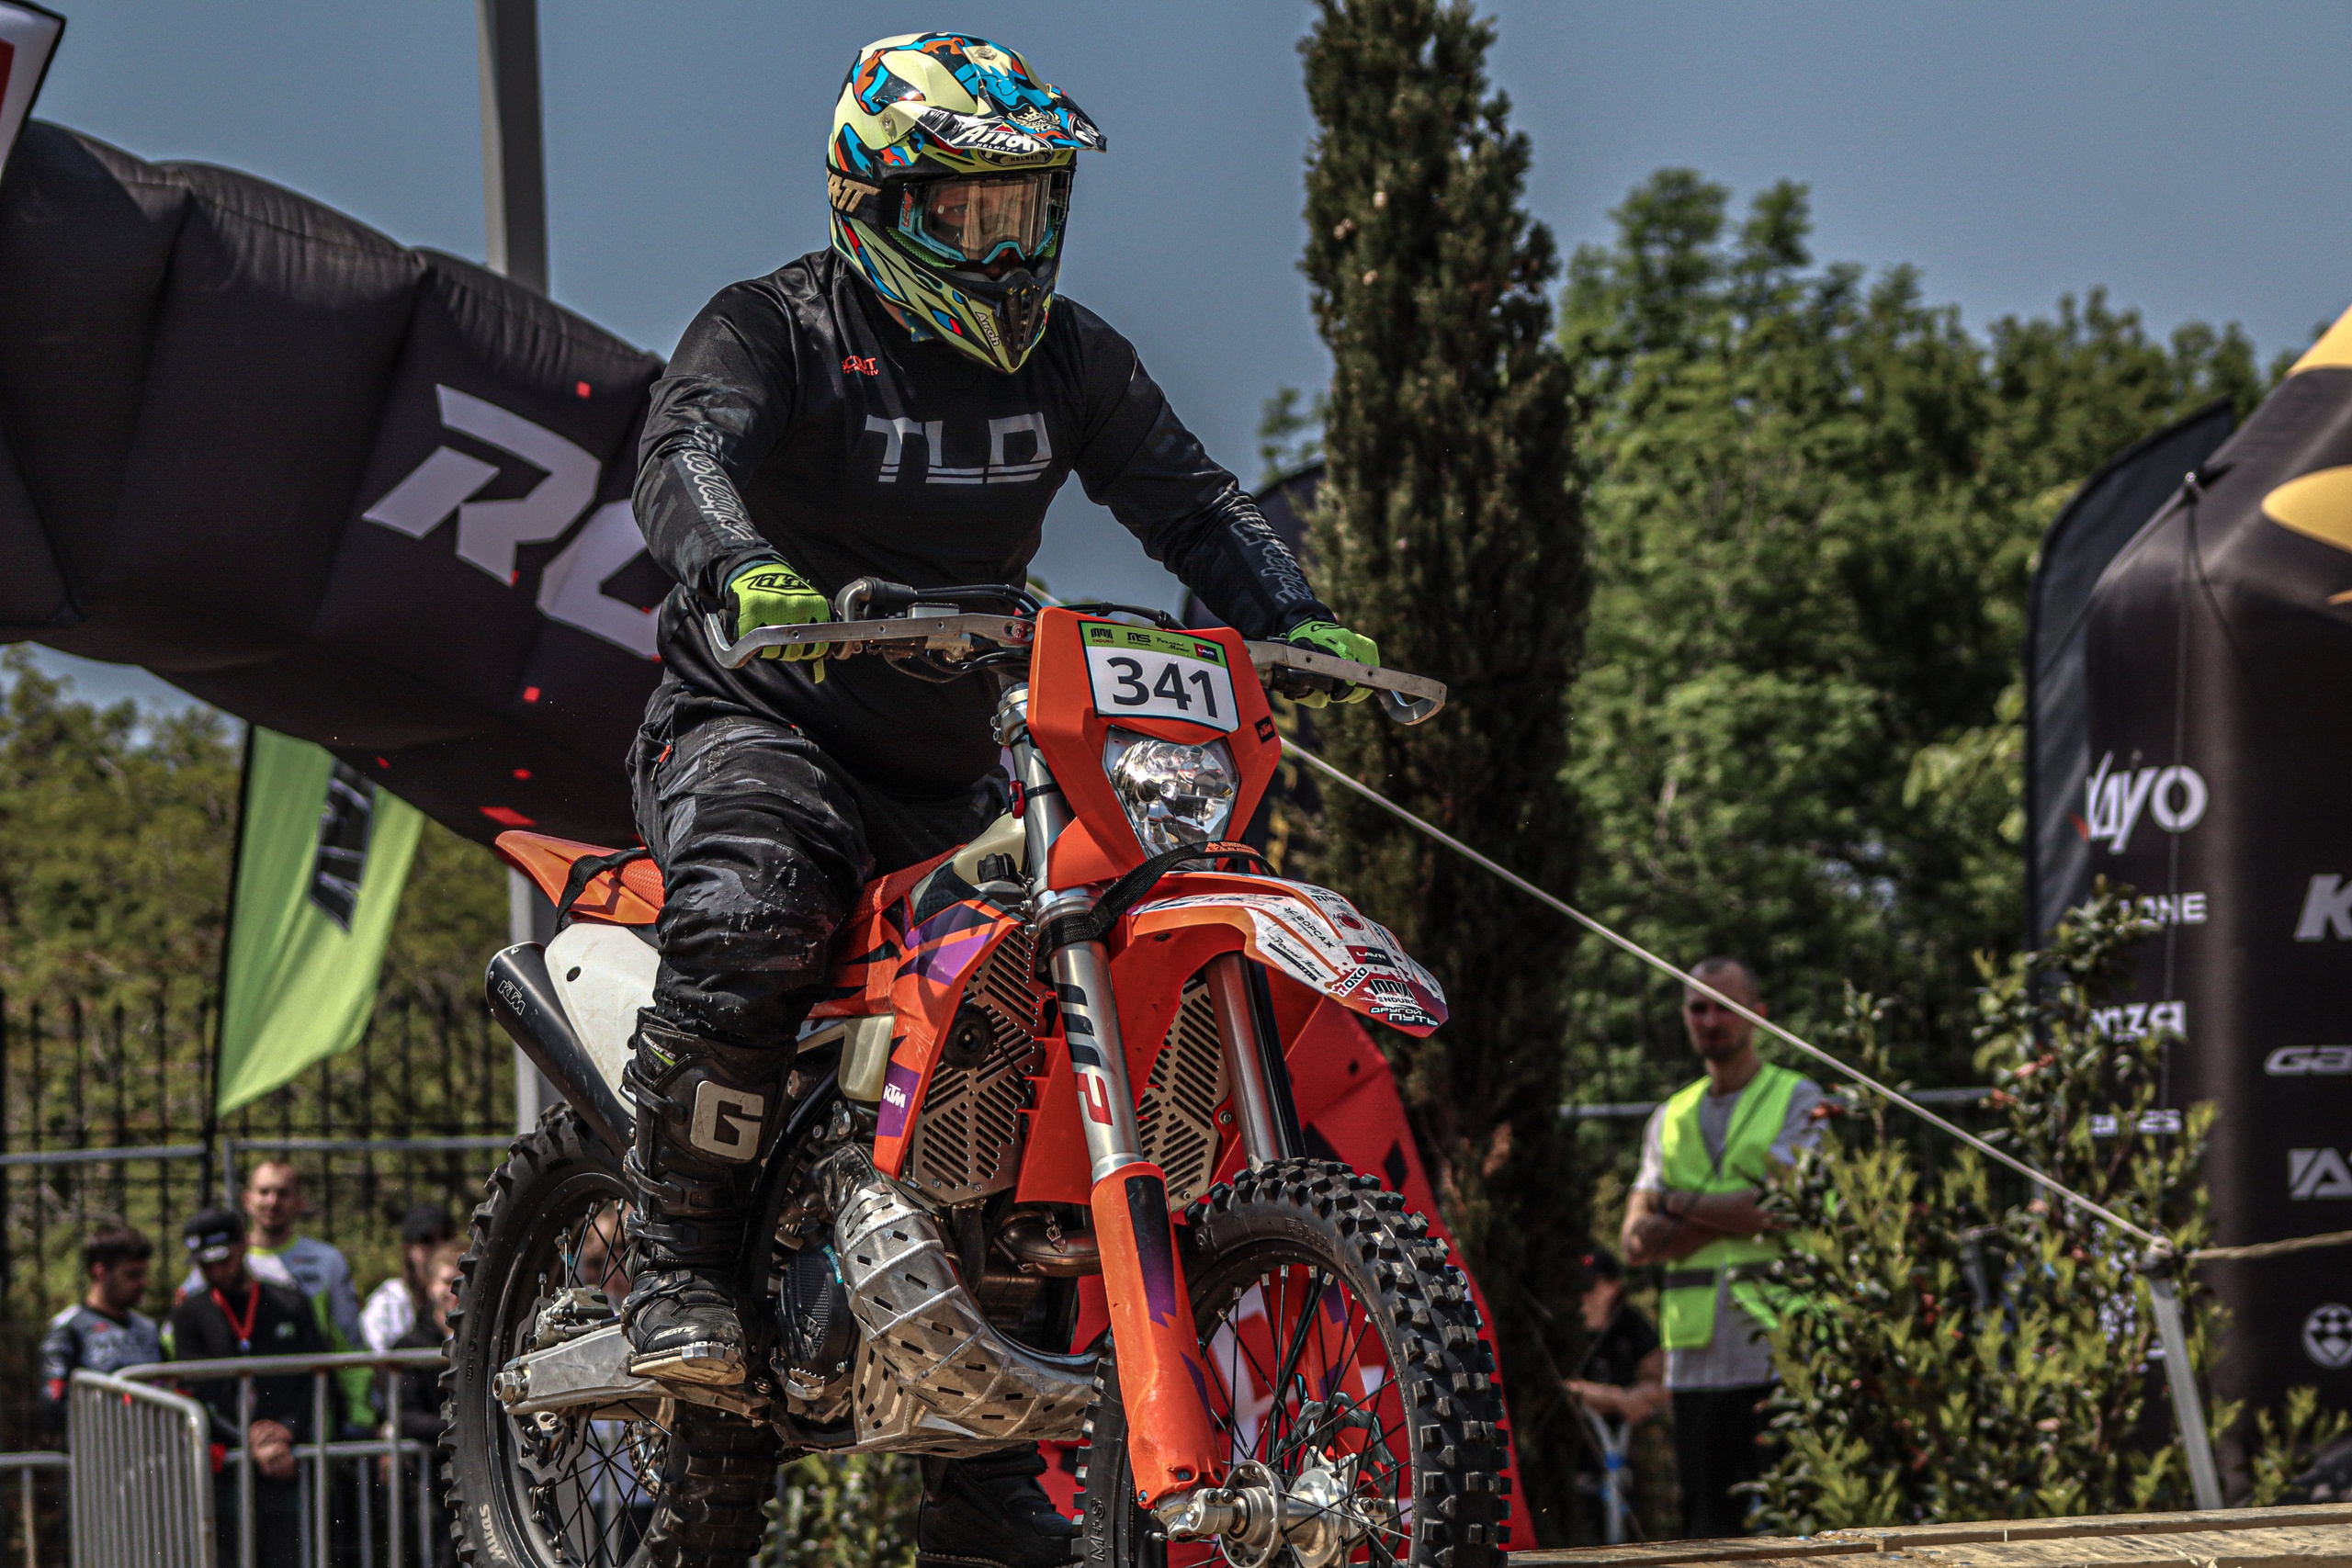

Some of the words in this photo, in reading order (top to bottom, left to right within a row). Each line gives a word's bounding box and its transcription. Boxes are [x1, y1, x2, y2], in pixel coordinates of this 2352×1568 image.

[1010, 154, 1038, 163] HELMET
[974, 311, 1001, 346] Airoh
[865, 412, 1053, 484] TLD
[1106, 657, 1218, 719] 341
[497, 979, 526, 1016] KTM
[1378, 997, 1419, 1006] ENDURO
[1388, 1012, 1439, 1026] ПУТЬ
[883, 1082, 907, 1108] KTM
[690, 1080, 764, 1161] G
